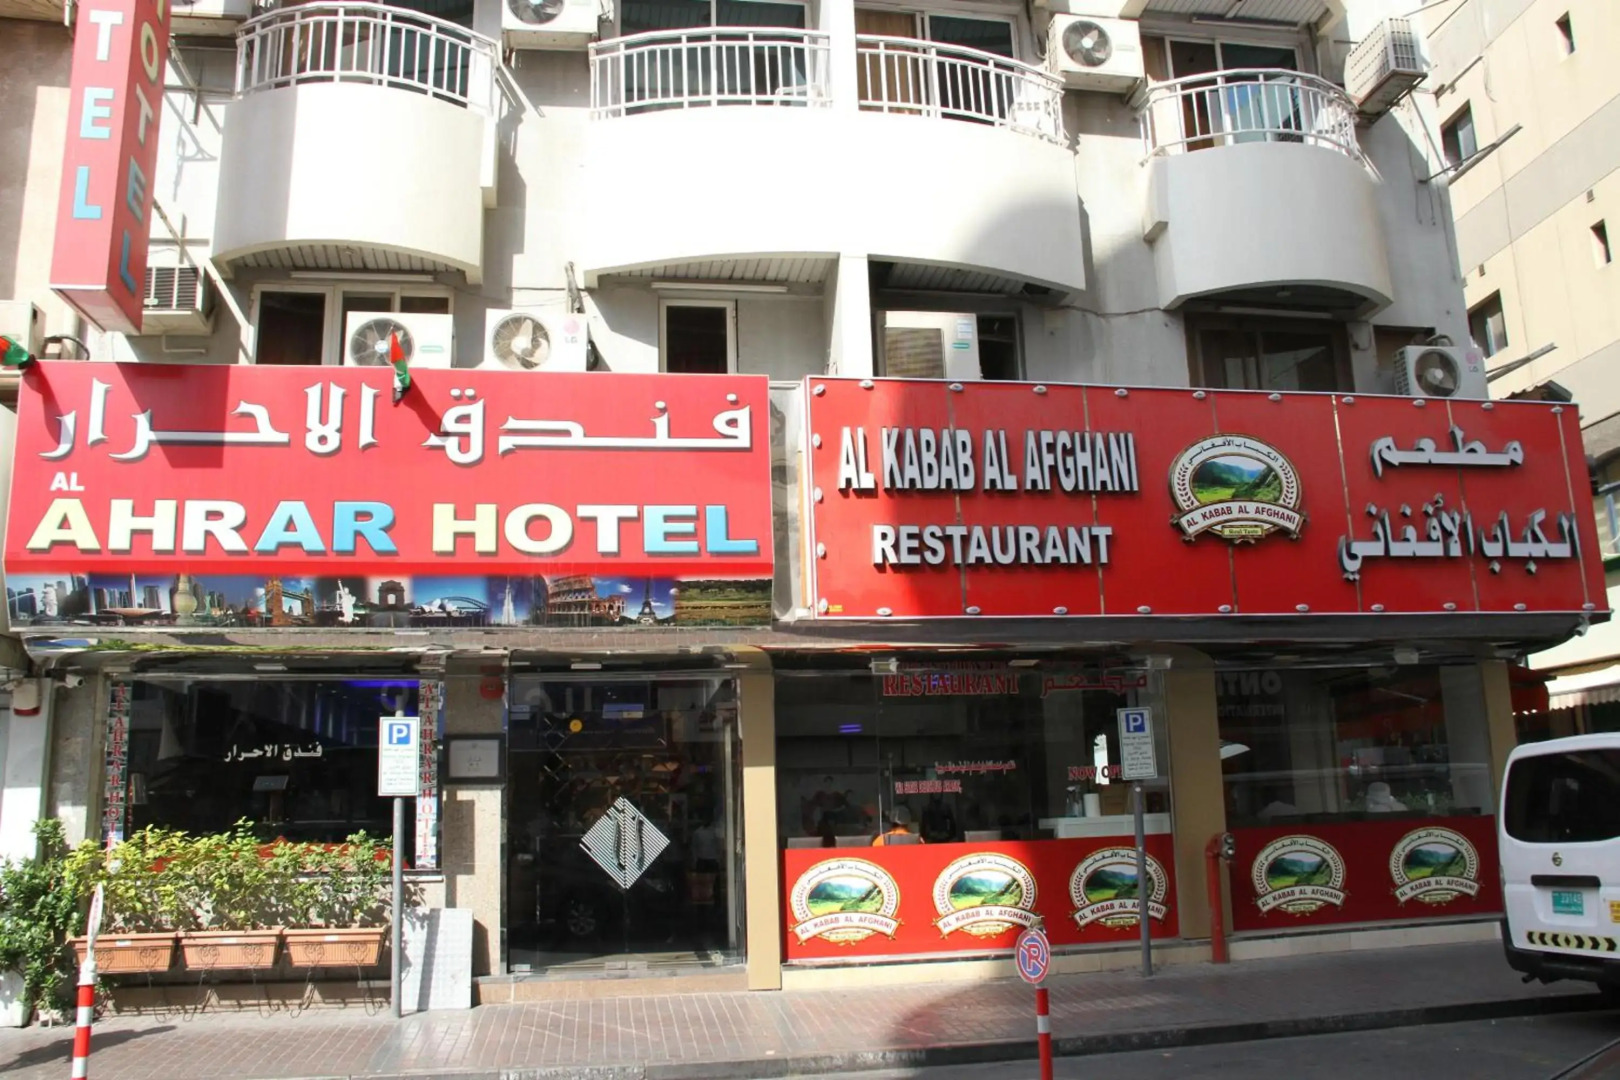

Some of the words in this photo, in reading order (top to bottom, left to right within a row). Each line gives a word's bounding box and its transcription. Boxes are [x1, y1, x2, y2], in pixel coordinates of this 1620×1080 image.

[118, 0, 164, 294] OTEL
[38, 377, 381, 461] الاحرار
[421, 388, 752, 464] فندق
[838, 427, 875, 490] AL
[881, 427, 976, 490] KABAB
[983, 430, 1018, 491] AL
[1024, 430, 1139, 492] AFGHANI
[1370, 425, 1525, 478] مطعم
[50, 472, 85, 491] AL
[25, 498, 398, 554] AHRAR
[432, 503, 759, 554] HOTEL
[1186, 517, 1199, 529] AL
[1201, 506, 1233, 520] KABAB
[1238, 505, 1250, 515] AL
[1254, 506, 1297, 525] AFGHANI
[873, 525, 1113, 565] RESTAURANT
[1478, 509, 1584, 575] الكباب
[883, 674, 1020, 696] RESTAURANT
[392, 724, 409, 745] P
[1128, 714, 1142, 732] P
[223, 744, 278, 762] الاحرار
[282, 741, 323, 761] فندق
[1261, 899, 1271, 908] AL
[1272, 890, 1295, 901] KABAB
[1311, 888, 1341, 900] AFGHANI
[1079, 913, 1088, 921] AL
[1090, 903, 1115, 915] KABAB
